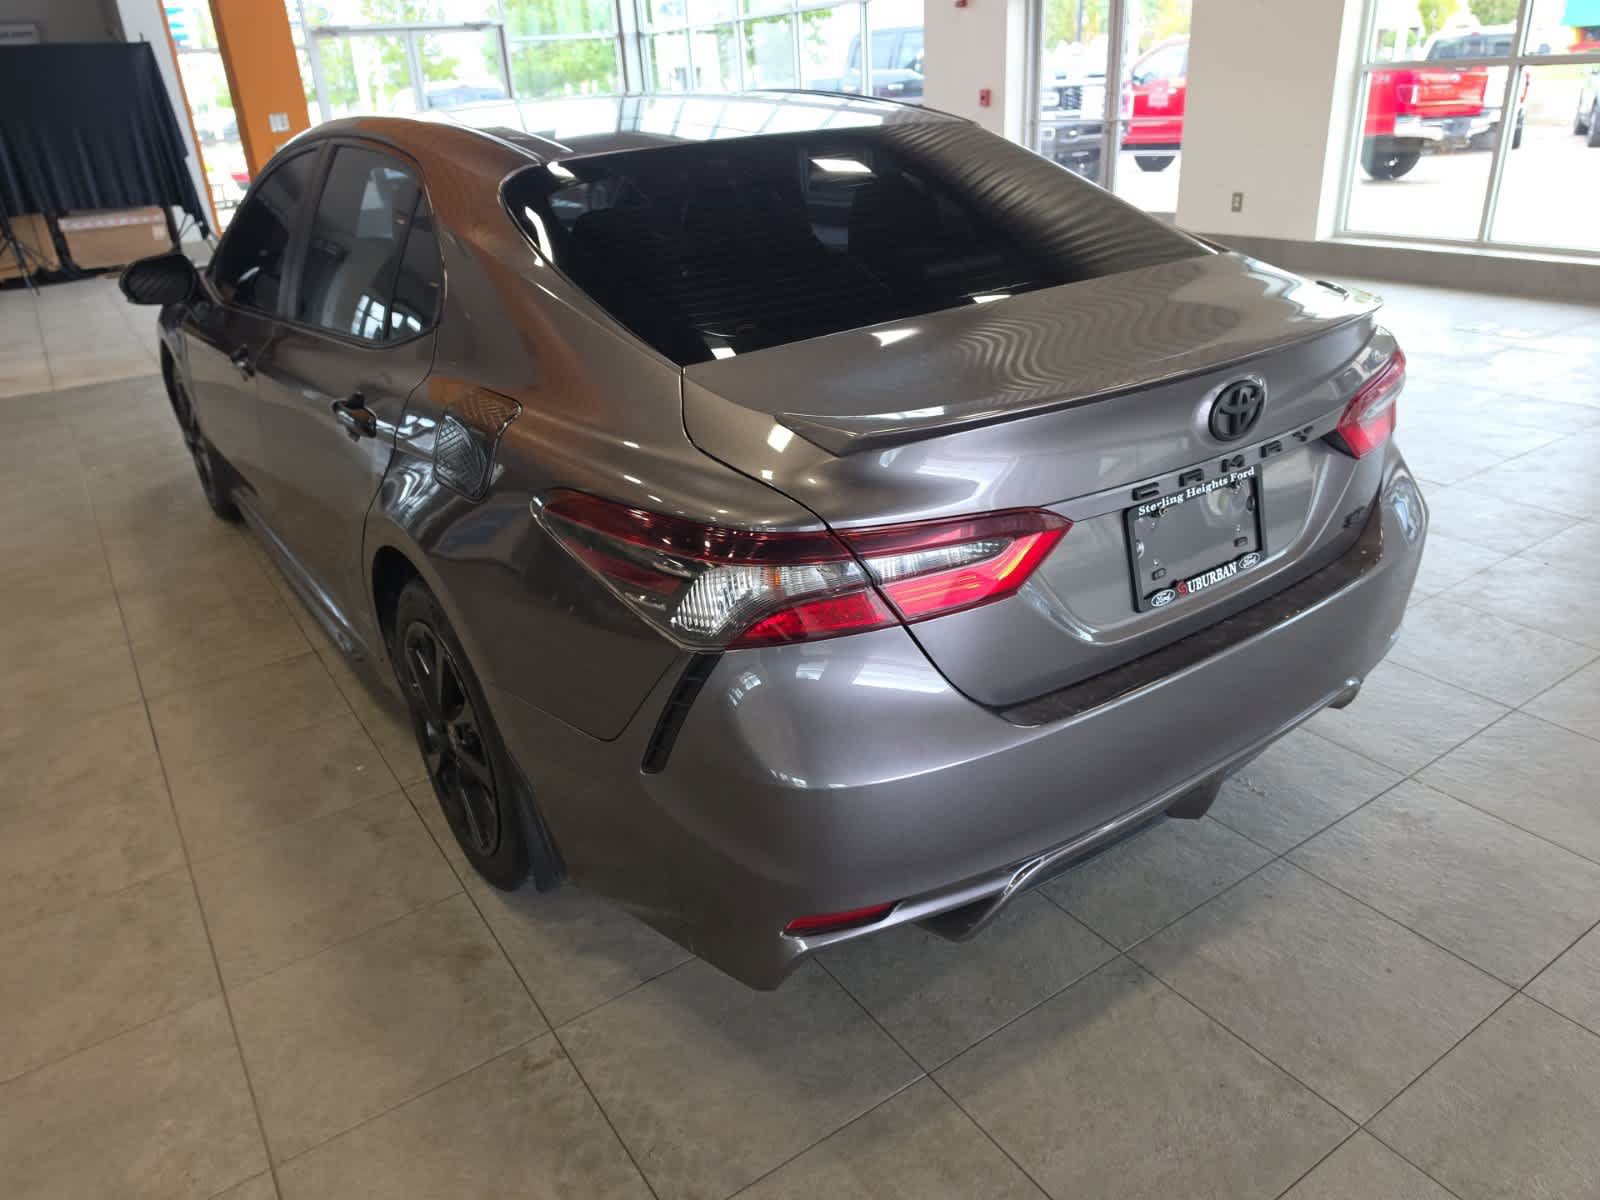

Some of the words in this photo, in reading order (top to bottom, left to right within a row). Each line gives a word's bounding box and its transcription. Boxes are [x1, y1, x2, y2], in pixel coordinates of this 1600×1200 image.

[1138, 493, 1184, 516] Sterling
[1186, 477, 1229, 498] Heights
[1230, 466, 1255, 482] Ford
[1176, 562, 1237, 597] SUBURBAN
